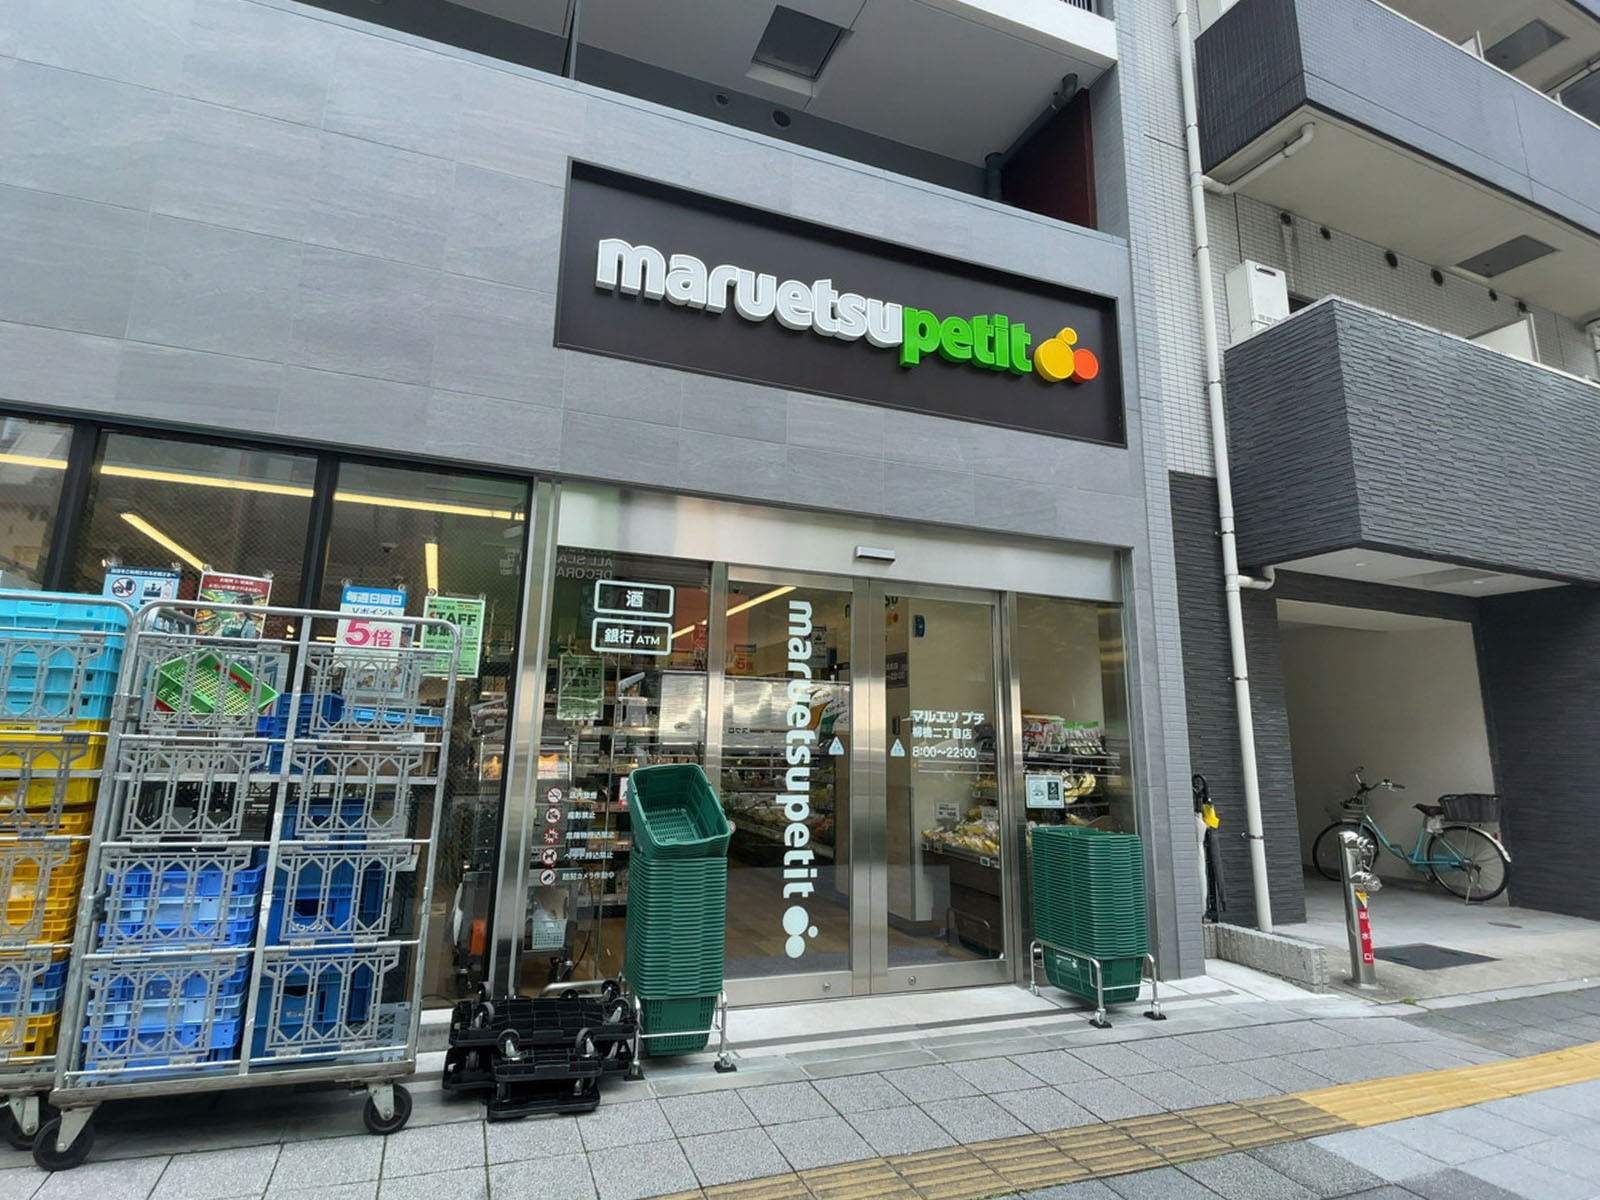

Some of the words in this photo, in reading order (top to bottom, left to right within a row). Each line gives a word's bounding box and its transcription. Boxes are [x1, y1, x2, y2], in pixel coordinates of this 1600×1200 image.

[346, 590, 403, 606] 毎週日曜日
[626, 590, 644, 608] 酒
[345, 620, 393, 648] 5倍
[604, 628, 634, 644] 銀行
[636, 635, 660, 646] ATM
[911, 710, 959, 724] マルエツ
[961, 711, 985, 725] プチ
[776, 600, 818, 899] maruetsupetit
